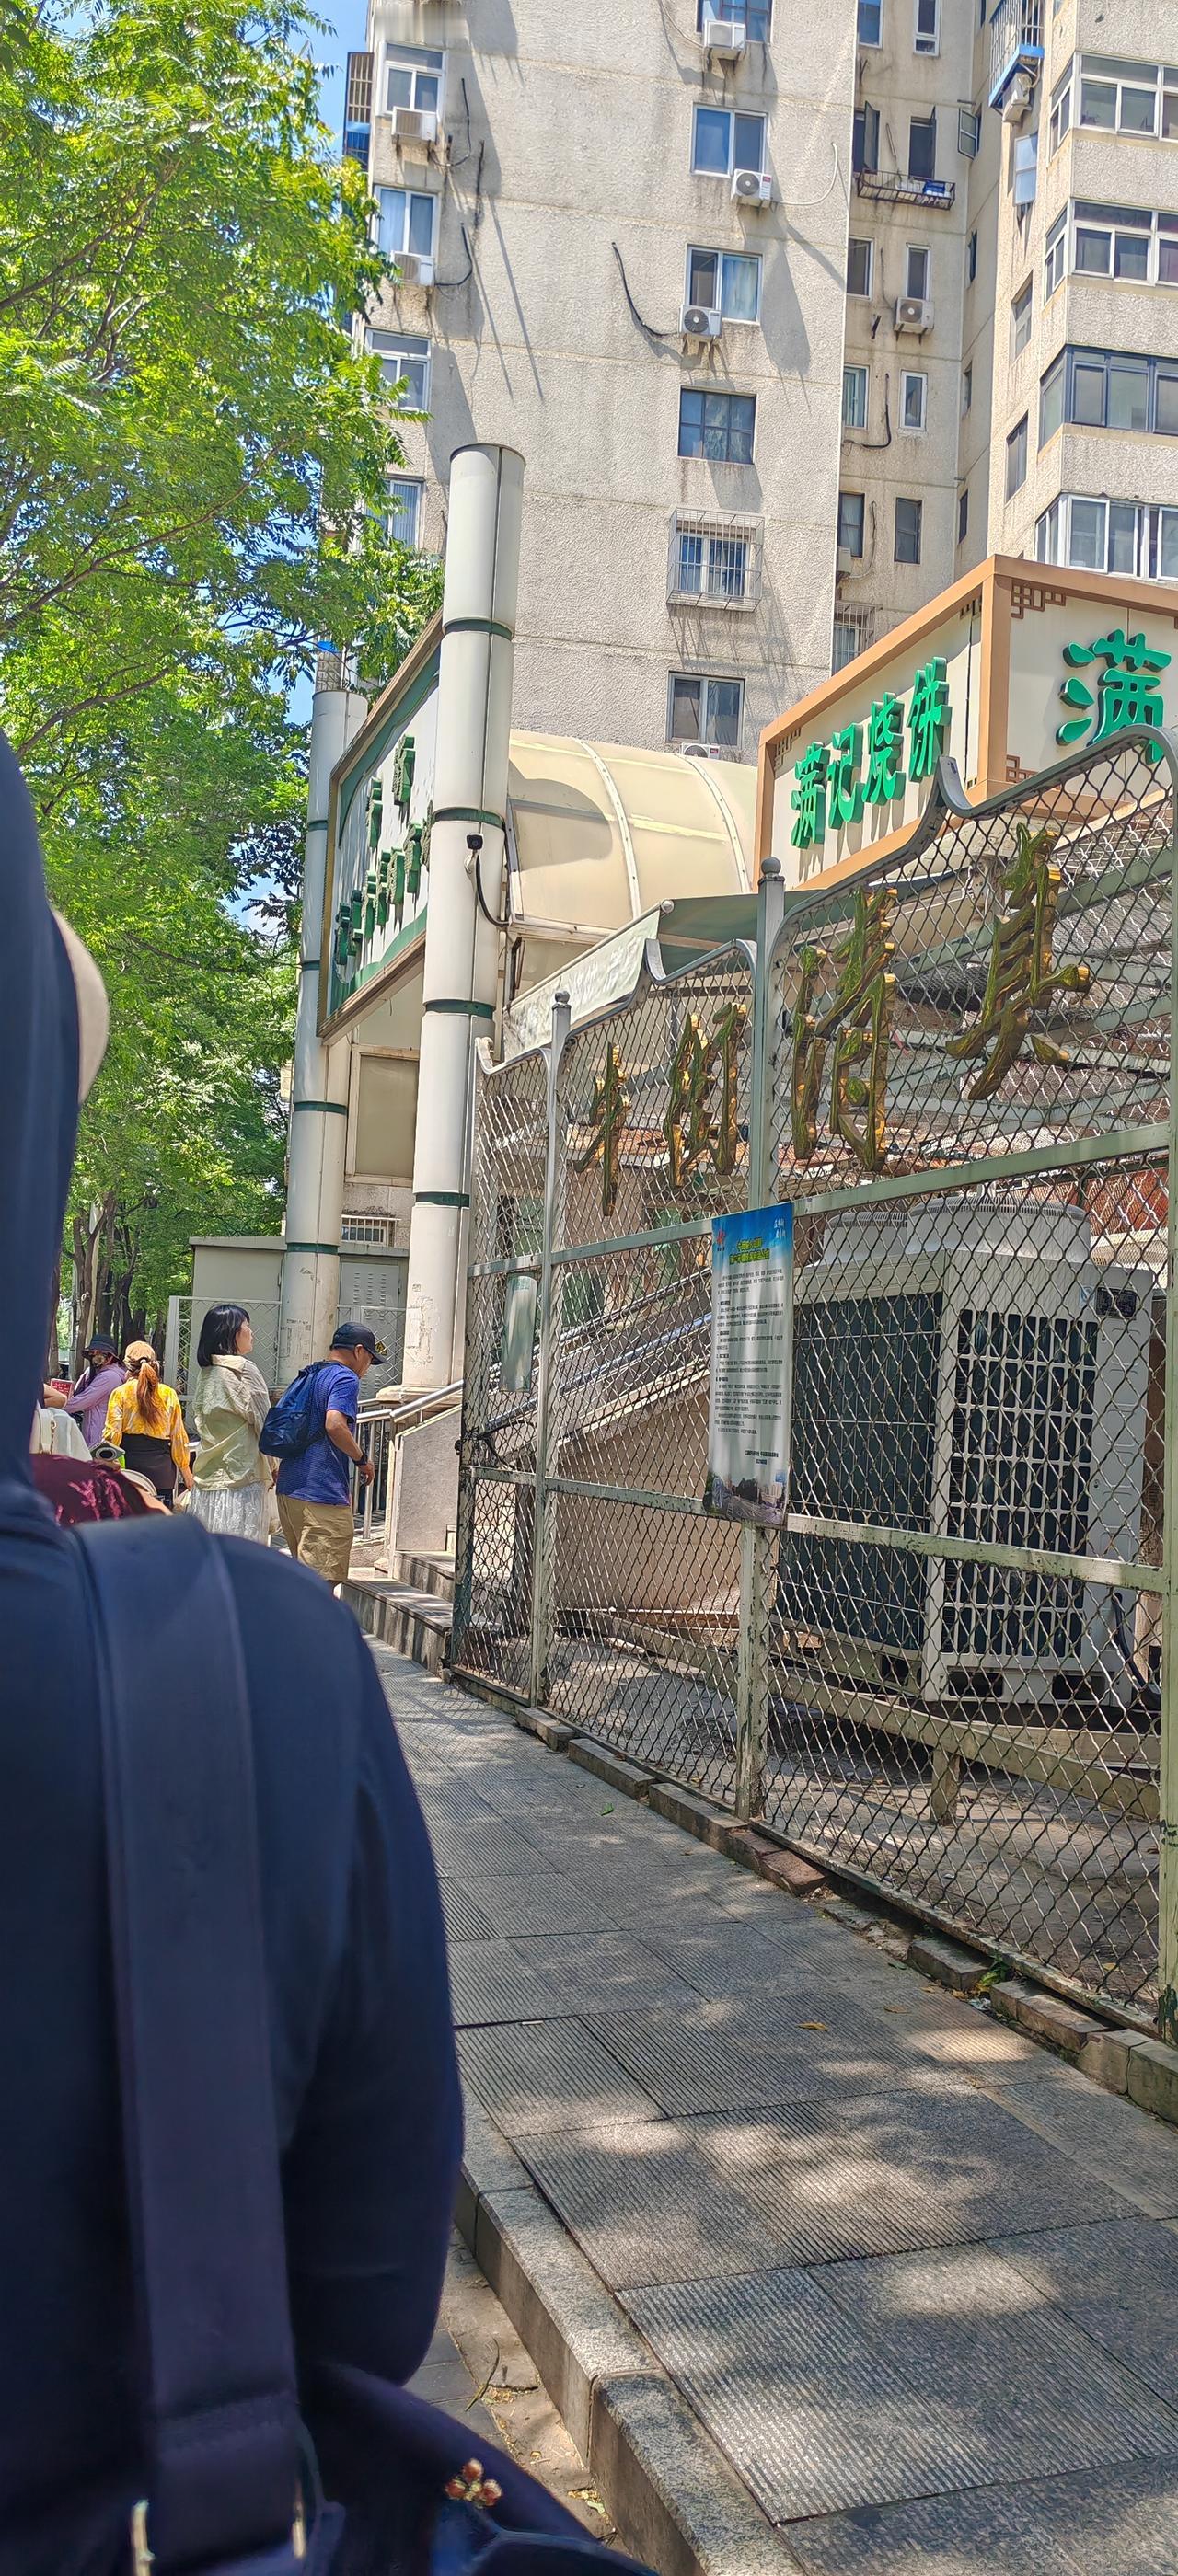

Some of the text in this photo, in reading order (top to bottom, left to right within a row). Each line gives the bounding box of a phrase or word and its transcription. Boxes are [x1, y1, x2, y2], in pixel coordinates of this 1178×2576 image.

[791, 656, 952, 850] 满记烧饼
[1056, 628, 1171, 764] 满
